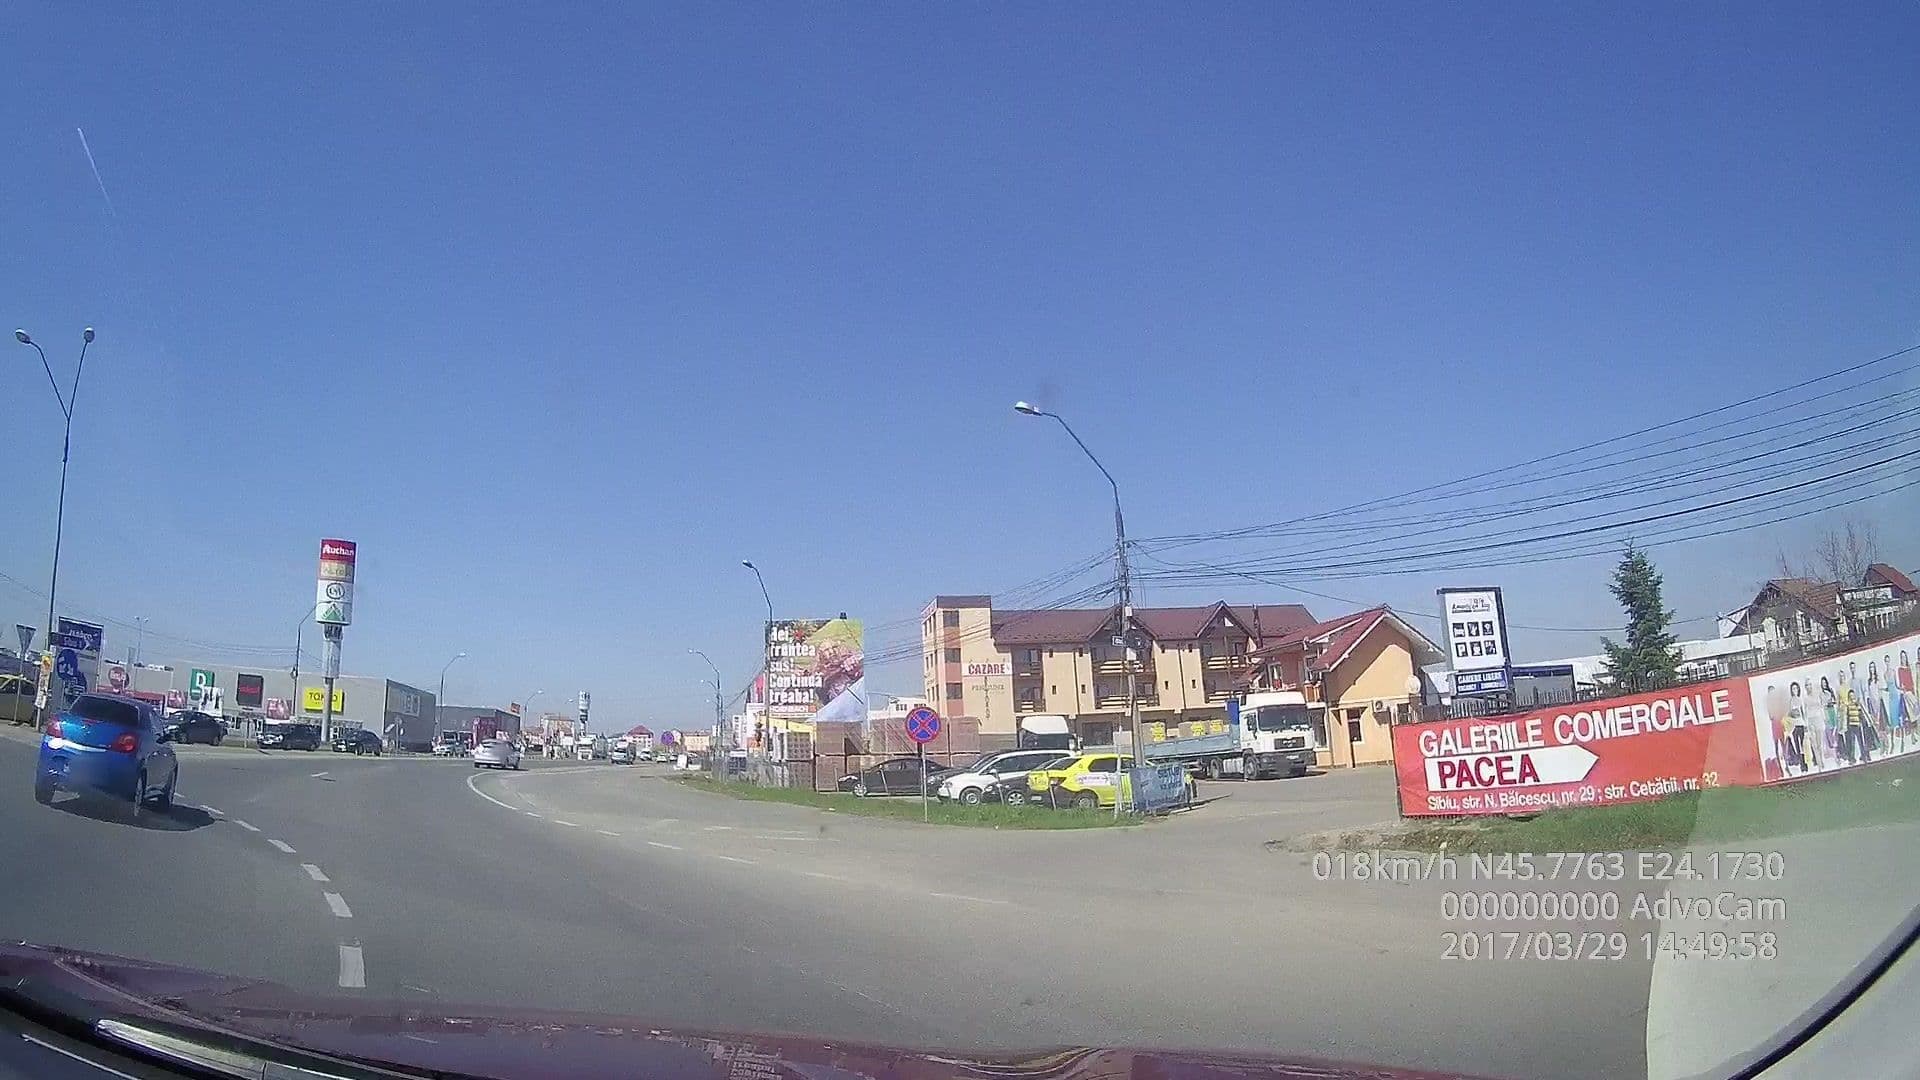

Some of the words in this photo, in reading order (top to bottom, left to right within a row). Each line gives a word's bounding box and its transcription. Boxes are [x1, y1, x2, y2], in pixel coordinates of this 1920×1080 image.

[322, 544, 355, 556] Auchan
[968, 663, 1006, 675] CAZARE
[1419, 718, 1545, 758] GALERIILE
[1553, 689, 1733, 744] COMERCIALE
[1437, 754, 1541, 789] PACEA
[1427, 793, 1460, 811] Sibiu,
[1462, 795, 1483, 810] str.
[1485, 793, 1498, 809] N.
[1500, 790, 1559, 808] Bălcescu,
[1561, 790, 1576, 803] nr.
[1579, 785, 1595, 801] 29
[1604, 784, 1627, 800] str.
[1683, 779, 1701, 792] nr.
[1702, 771, 1720, 787] 32
